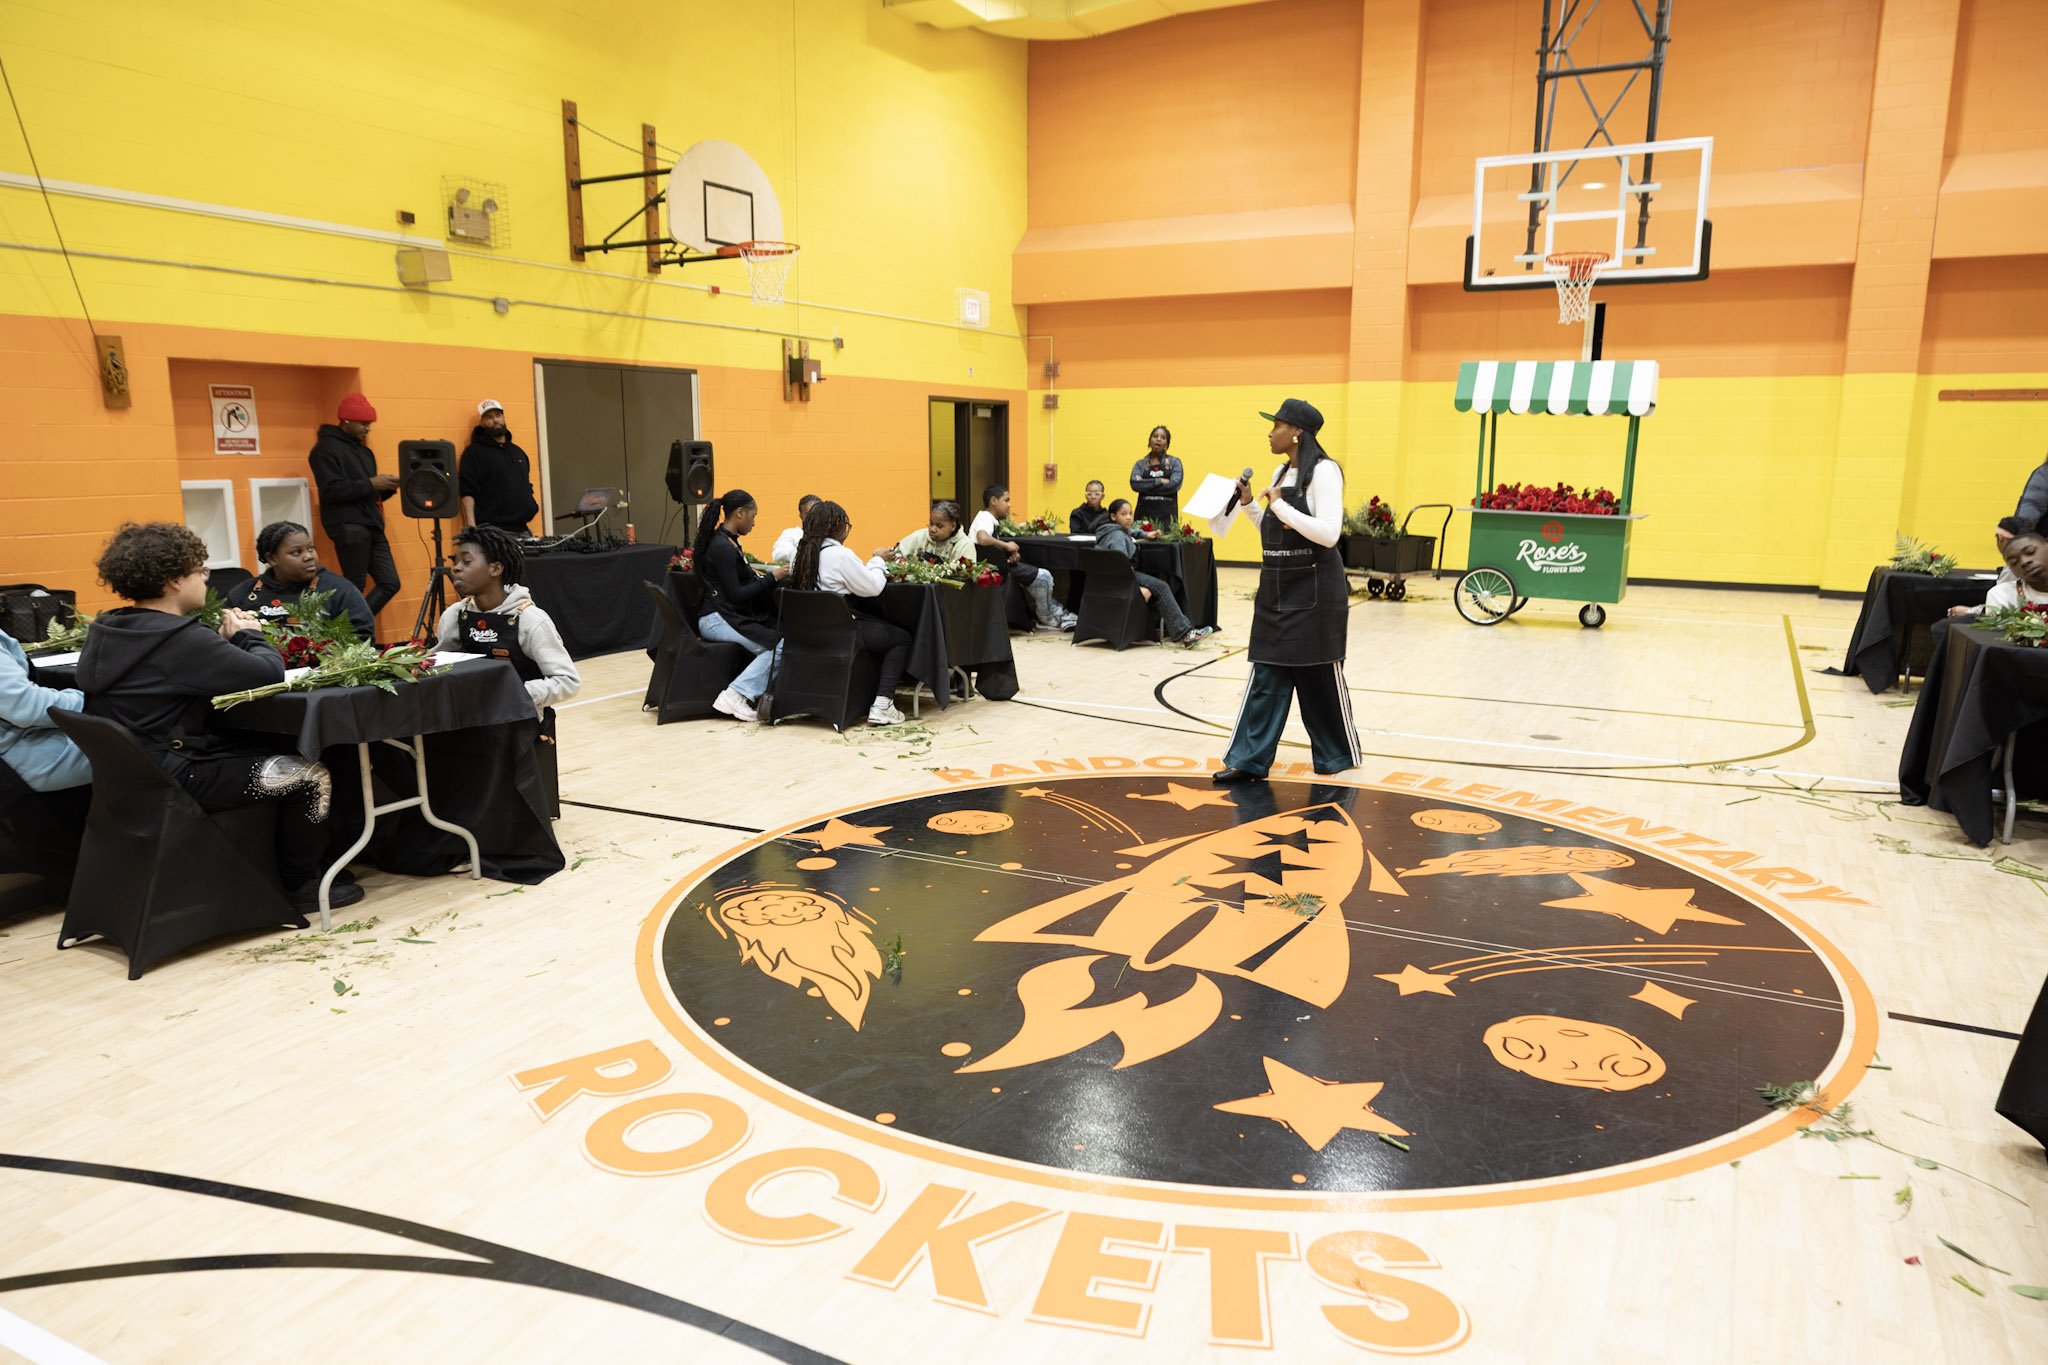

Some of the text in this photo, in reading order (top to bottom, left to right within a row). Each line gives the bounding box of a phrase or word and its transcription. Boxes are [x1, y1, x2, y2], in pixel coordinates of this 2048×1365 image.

[1516, 539, 1587, 571] Rose's
[1379, 771, 1874, 906] ELEMENTARY
[509, 1039, 1473, 1356] ROCKETS
